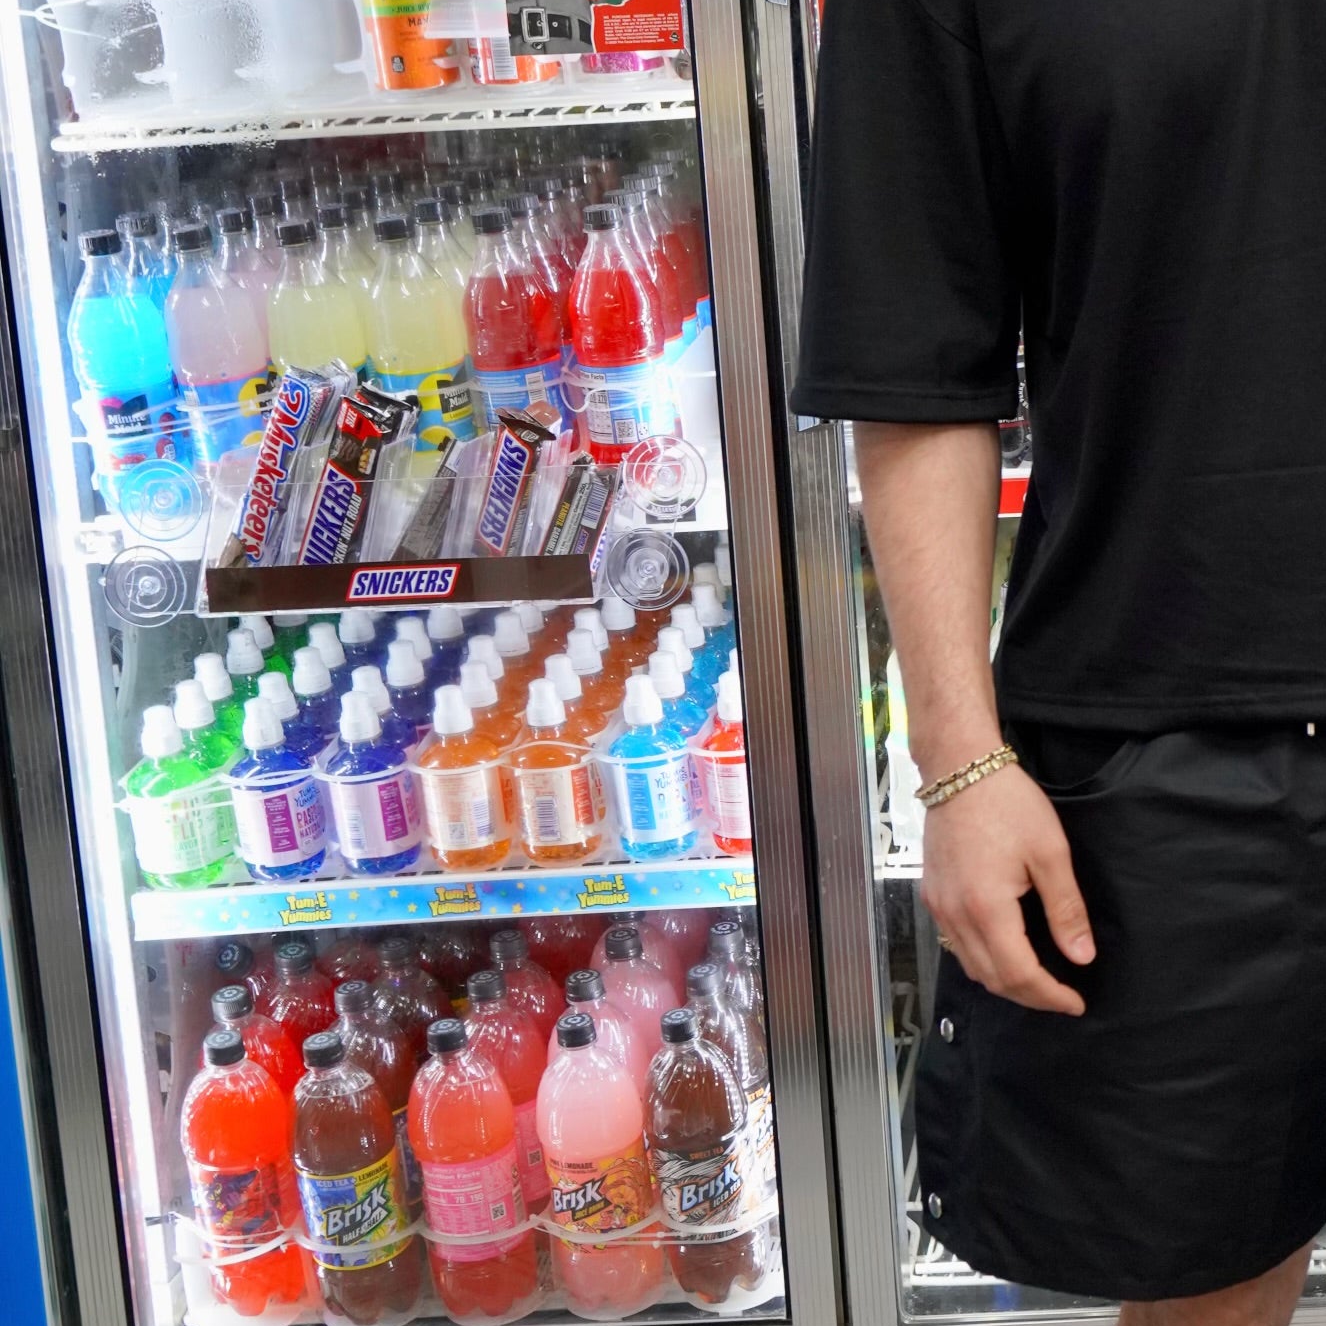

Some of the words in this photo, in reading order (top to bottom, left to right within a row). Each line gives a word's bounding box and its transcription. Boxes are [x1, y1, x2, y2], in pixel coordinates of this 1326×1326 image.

[243, 413, 300, 559] Musketeers
[480, 435, 529, 545] SNICKERS
[303, 468, 356, 564] NICKERS
[347, 491, 362, 519] ROAD
[342, 516, 356, 539] NUT
[353, 568, 455, 597] SNICKERS
[434, 883, 476, 903] Tum-E
[585, 875, 626, 894] Tum-E
[286, 892, 327, 911] Tum-E
[428, 898, 482, 917] Yummies
[576, 891, 630, 909] Yummies
[278, 905, 333, 926] Yummies
[358, 1162, 388, 1181] LEMONADE
[553, 1180, 603, 1213] Brisk
[682, 1159, 741, 1211] Brisk
[328, 1183, 388, 1237] Brisk
[713, 1190, 729, 1208] ICED
